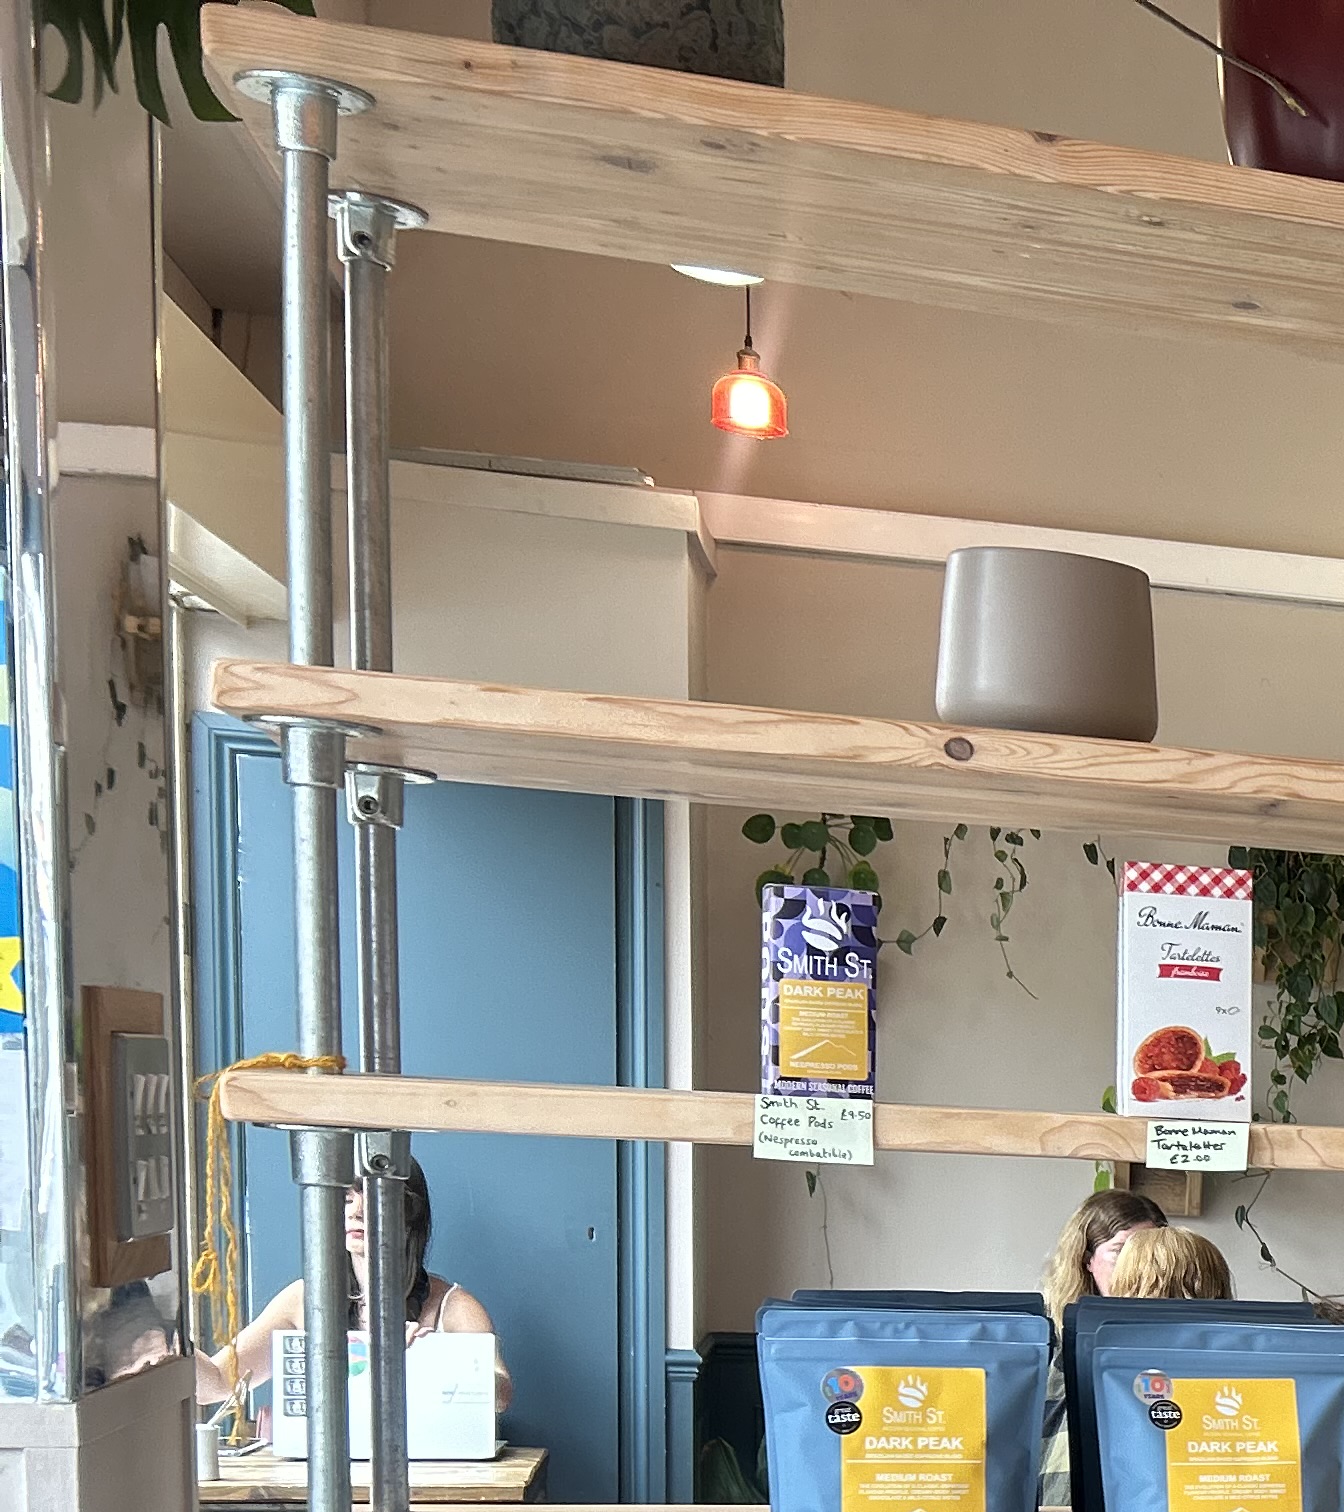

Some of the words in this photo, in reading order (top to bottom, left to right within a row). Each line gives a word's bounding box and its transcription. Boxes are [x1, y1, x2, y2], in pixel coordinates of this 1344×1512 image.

[1136, 905, 1182, 930] Bonne
[1183, 910, 1241, 934] Maman
[782, 984, 824, 998] DARK
[826, 987, 865, 1000] PEAK
[760, 1113, 801, 1130] Coffee
[808, 1115, 834, 1130] Pods
[827, 1412, 861, 1424] taste
[1150, 1409, 1181, 1420] taste
[864, 1436, 914, 1450] DARK
[916, 1436, 965, 1450] PEAK
[1187, 1440, 1232, 1453] DARK
[1235, 1440, 1279, 1453] PEAK
[918, 1472, 954, 1482] ROAST
[1238, 1473, 1272, 1482] ROAST
